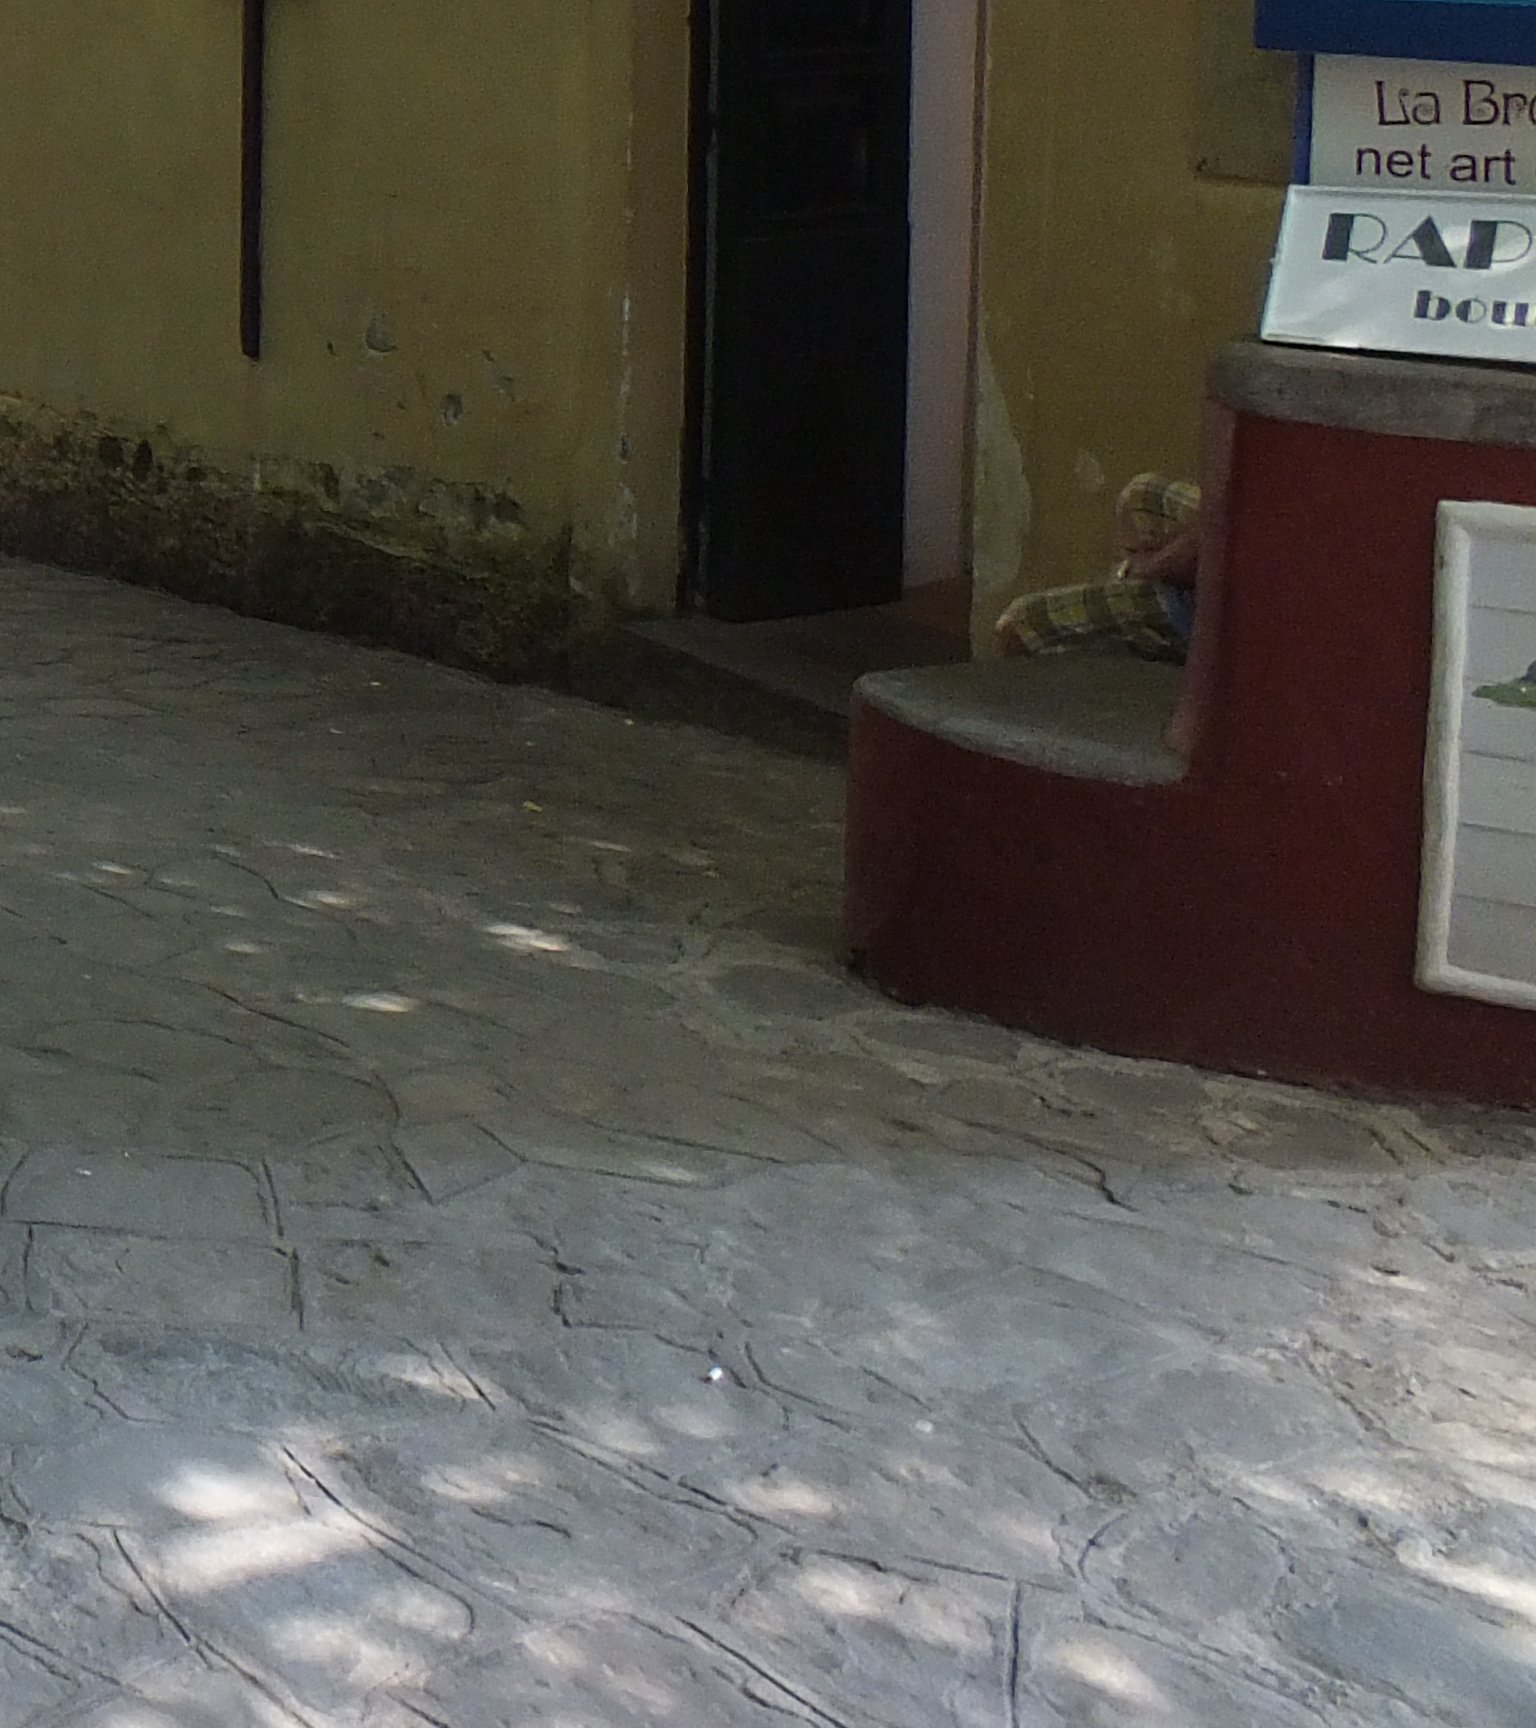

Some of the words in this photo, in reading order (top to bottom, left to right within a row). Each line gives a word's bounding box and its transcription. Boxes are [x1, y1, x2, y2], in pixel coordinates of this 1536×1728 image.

[1375, 79, 1441, 126] La
[1355, 143, 1432, 180] net
[1449, 148, 1517, 186] art
[1413, 289, 1536, 327] bou
